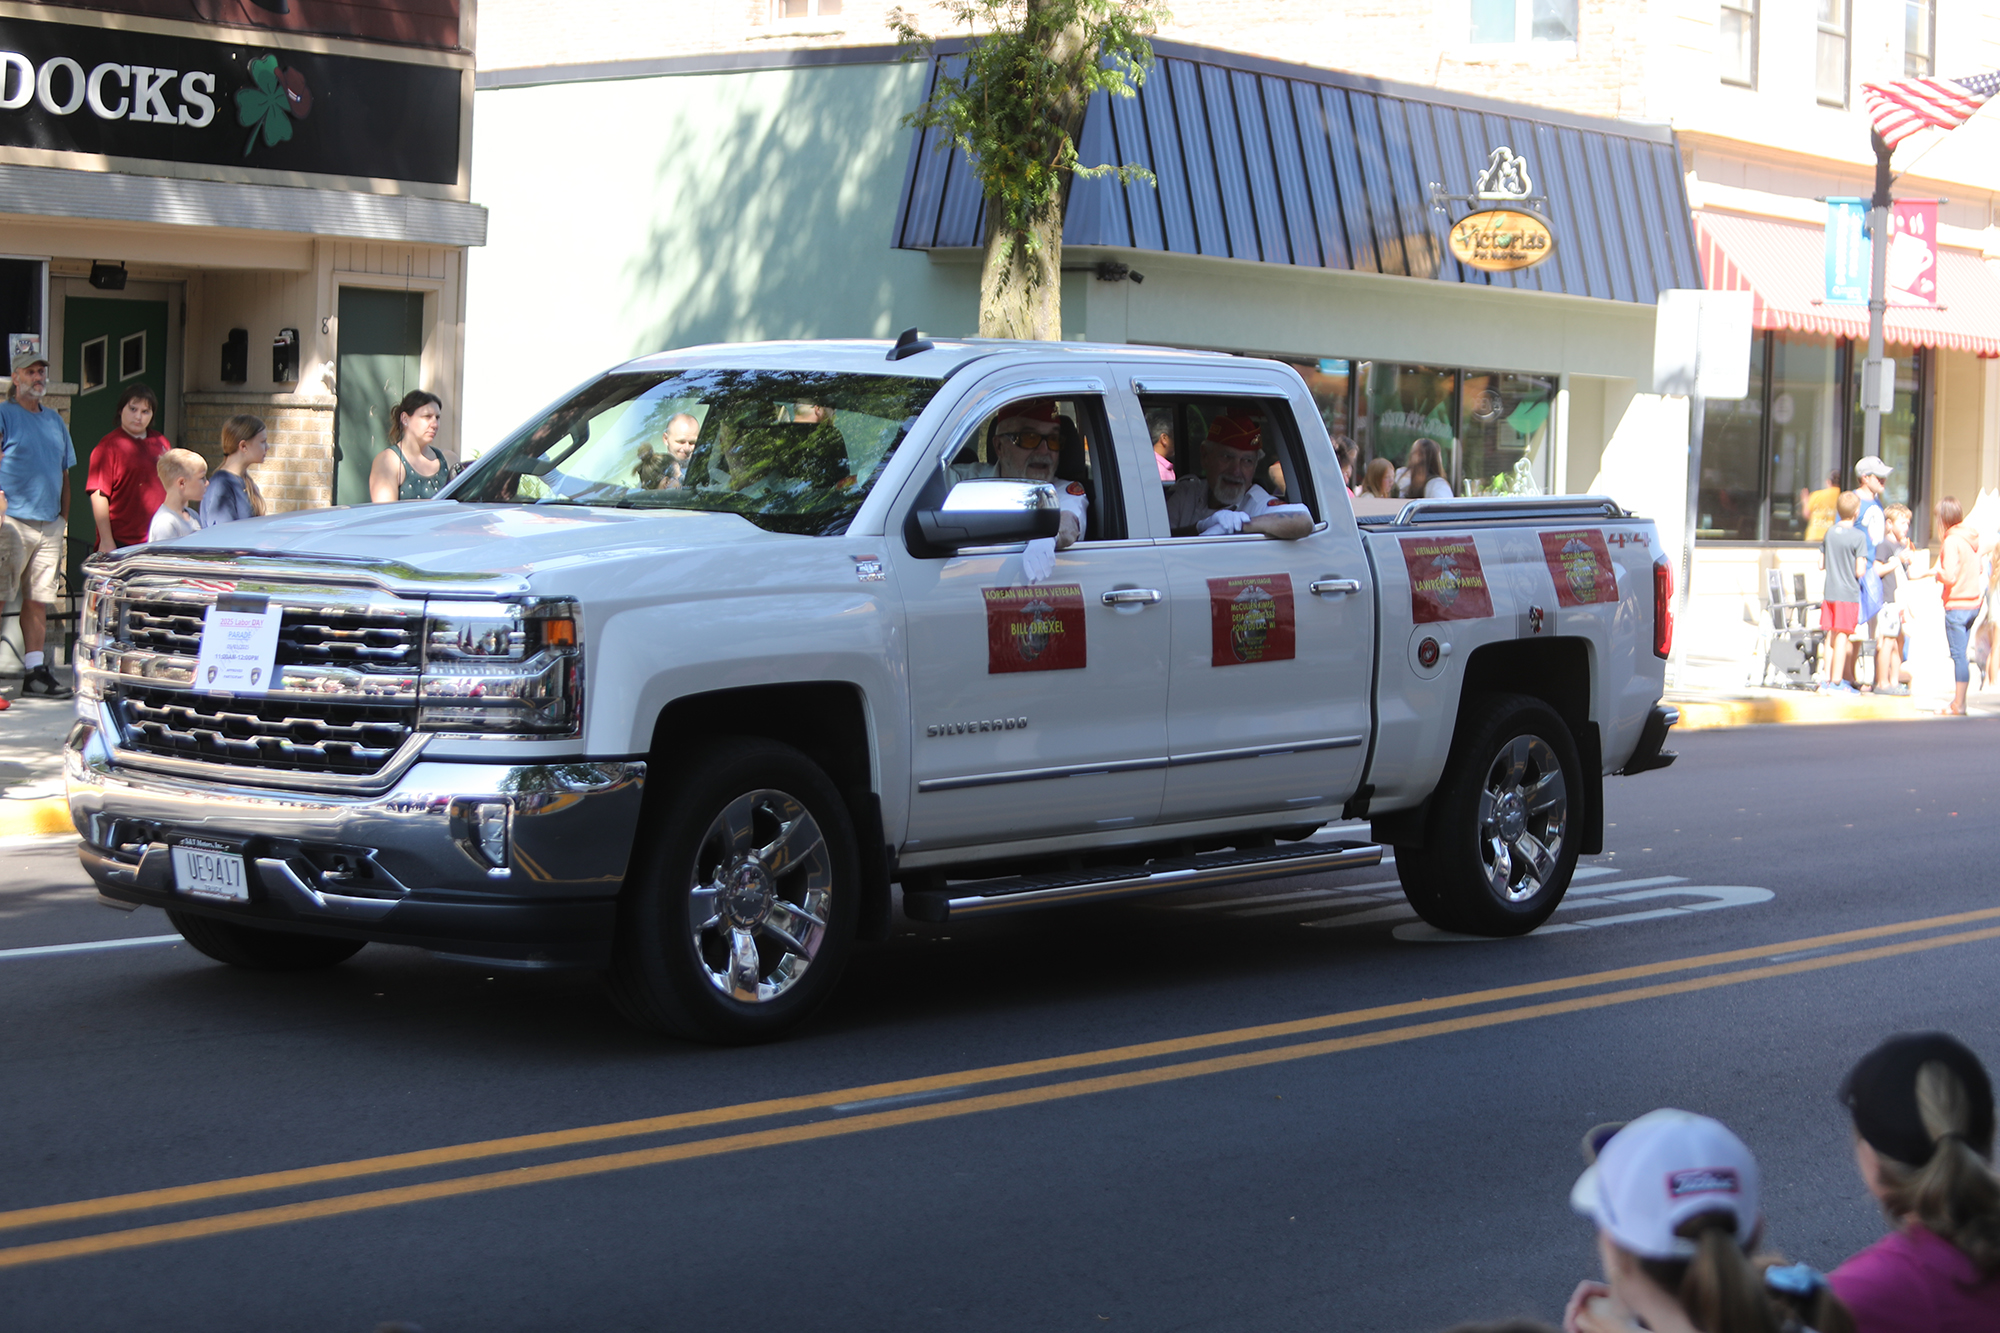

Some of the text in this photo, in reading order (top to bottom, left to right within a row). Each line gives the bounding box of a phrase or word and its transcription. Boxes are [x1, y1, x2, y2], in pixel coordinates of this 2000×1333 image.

[0, 51, 216, 128] DOCKS
[1414, 545, 1466, 555] VIETNAM VETERAN
[1415, 576, 1483, 591] LAWRENCE PARISH
[985, 587, 1081, 599] KOREAN WAR ERA VETERAN
[220, 618, 234, 626] 2025
[235, 618, 250, 626] Labor
[1011, 621, 1064, 635] BILL DREXEL
[228, 631, 252, 639] PARADE
[927, 716, 1028, 738] SILVERADO
[187, 851, 240, 887] UE9417
